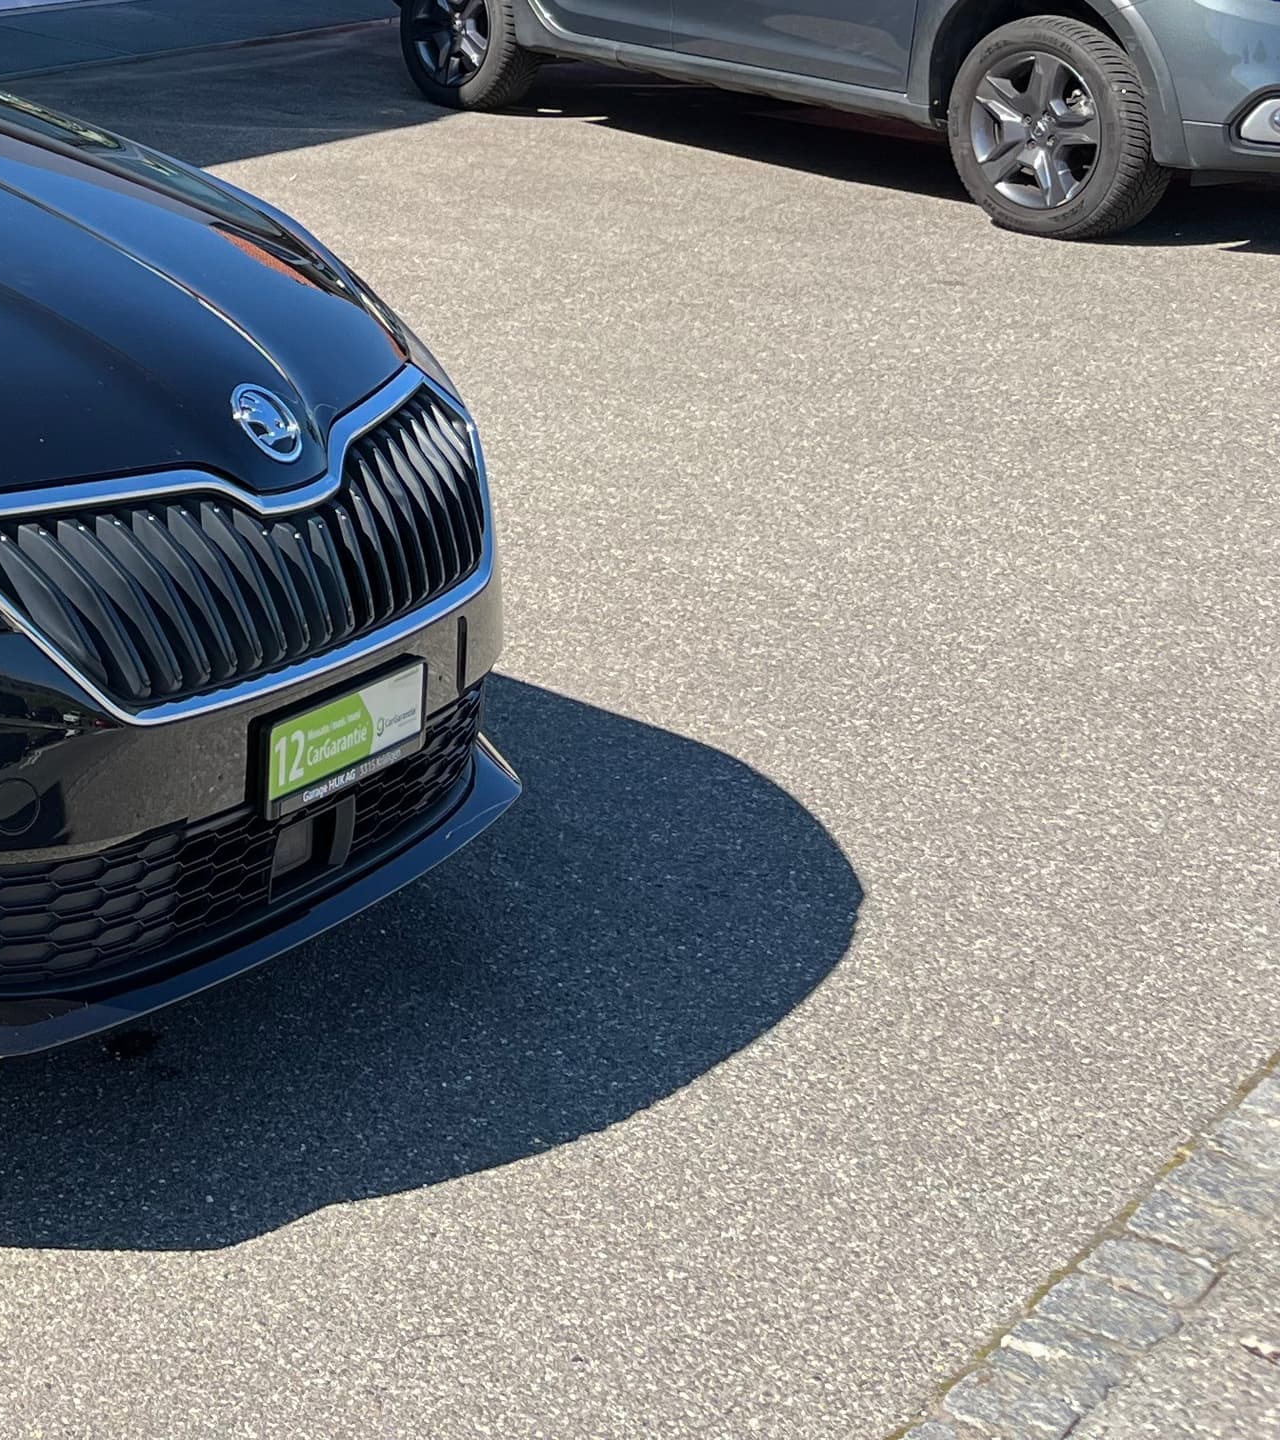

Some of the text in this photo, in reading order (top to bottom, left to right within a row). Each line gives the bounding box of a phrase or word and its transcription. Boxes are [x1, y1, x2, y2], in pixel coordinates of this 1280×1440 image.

[274, 729, 305, 787] 12
[306, 723, 368, 766] CarGarantie
[302, 784, 329, 802] Garage
[328, 774, 345, 791] HUK
[344, 768, 357, 782] AG
